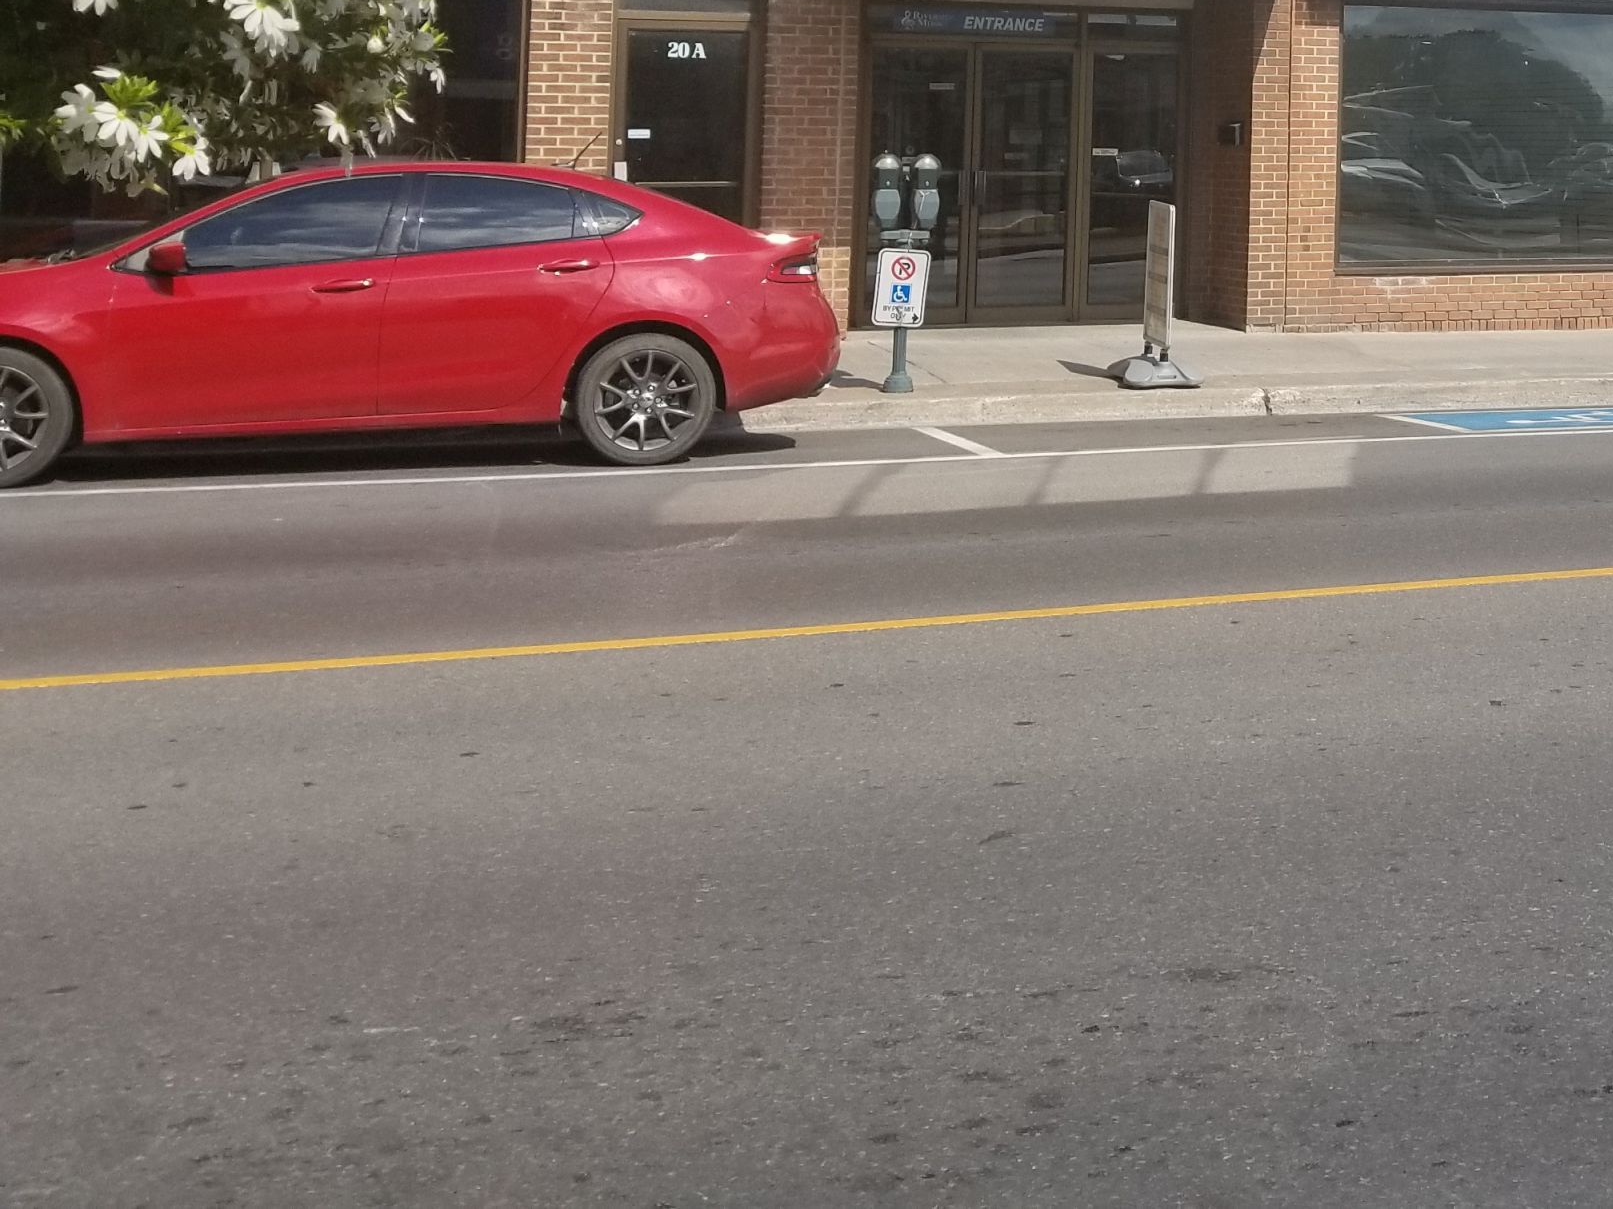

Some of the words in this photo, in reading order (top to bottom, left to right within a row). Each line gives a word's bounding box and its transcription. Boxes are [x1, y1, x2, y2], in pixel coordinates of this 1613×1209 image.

[963, 15, 1045, 32] ENTRANCE
[667, 41, 690, 59] 20
[692, 42, 707, 59] A
